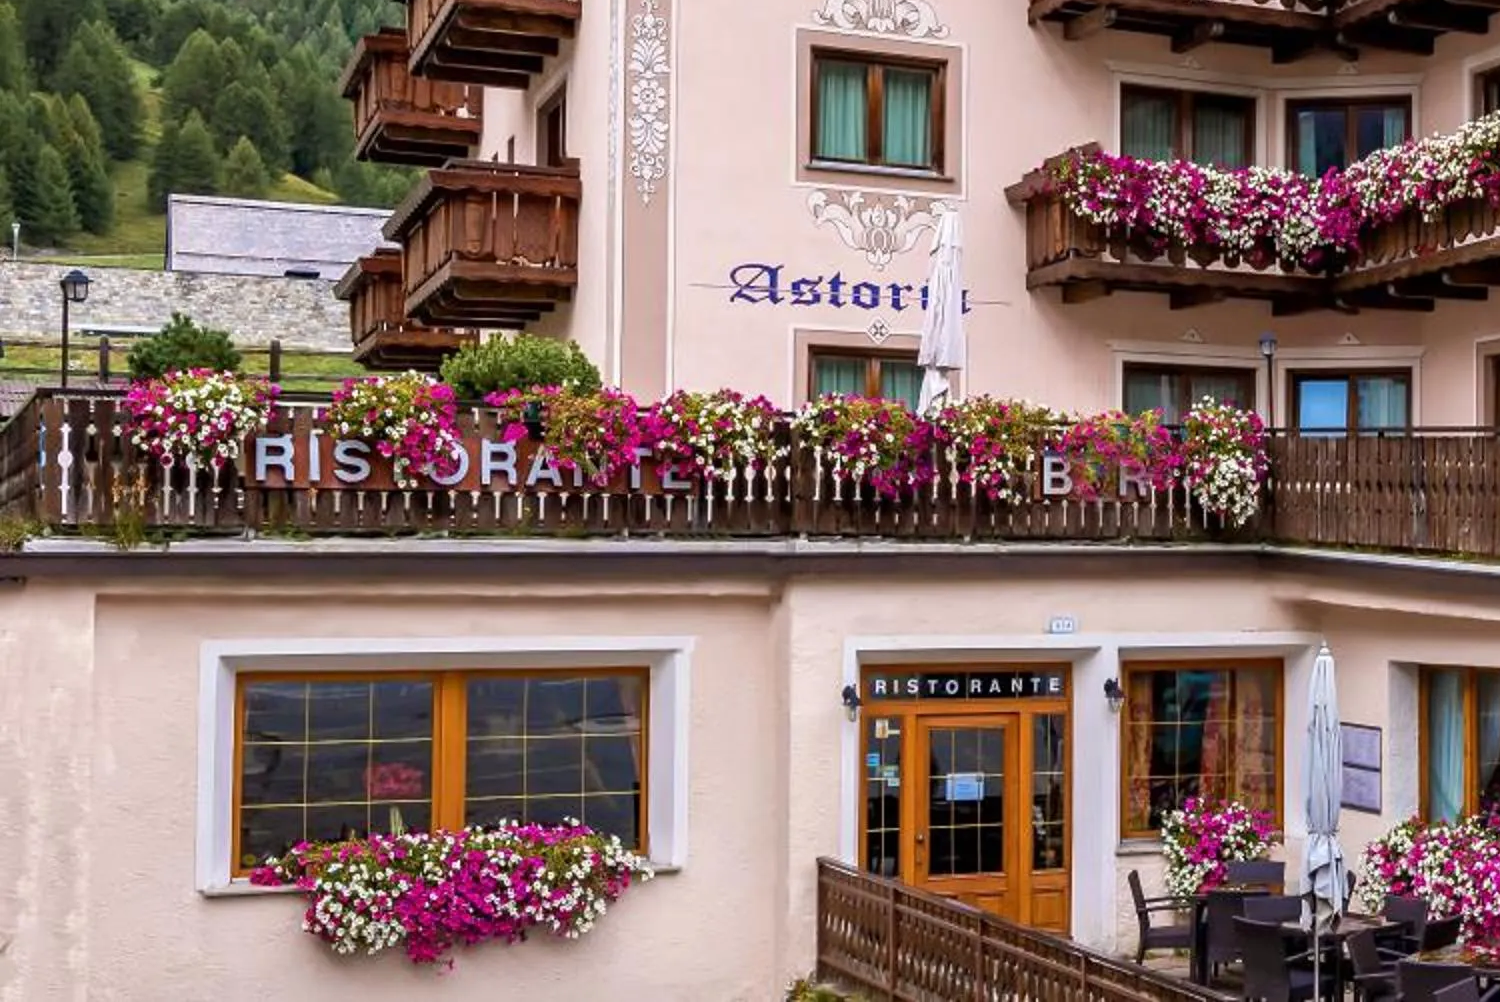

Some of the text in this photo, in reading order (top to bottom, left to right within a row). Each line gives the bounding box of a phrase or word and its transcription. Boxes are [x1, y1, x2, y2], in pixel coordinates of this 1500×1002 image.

[730, 263, 971, 314] Astori
[1043, 455, 1147, 496] BR
[875, 677, 1062, 695] RISTORANTE
